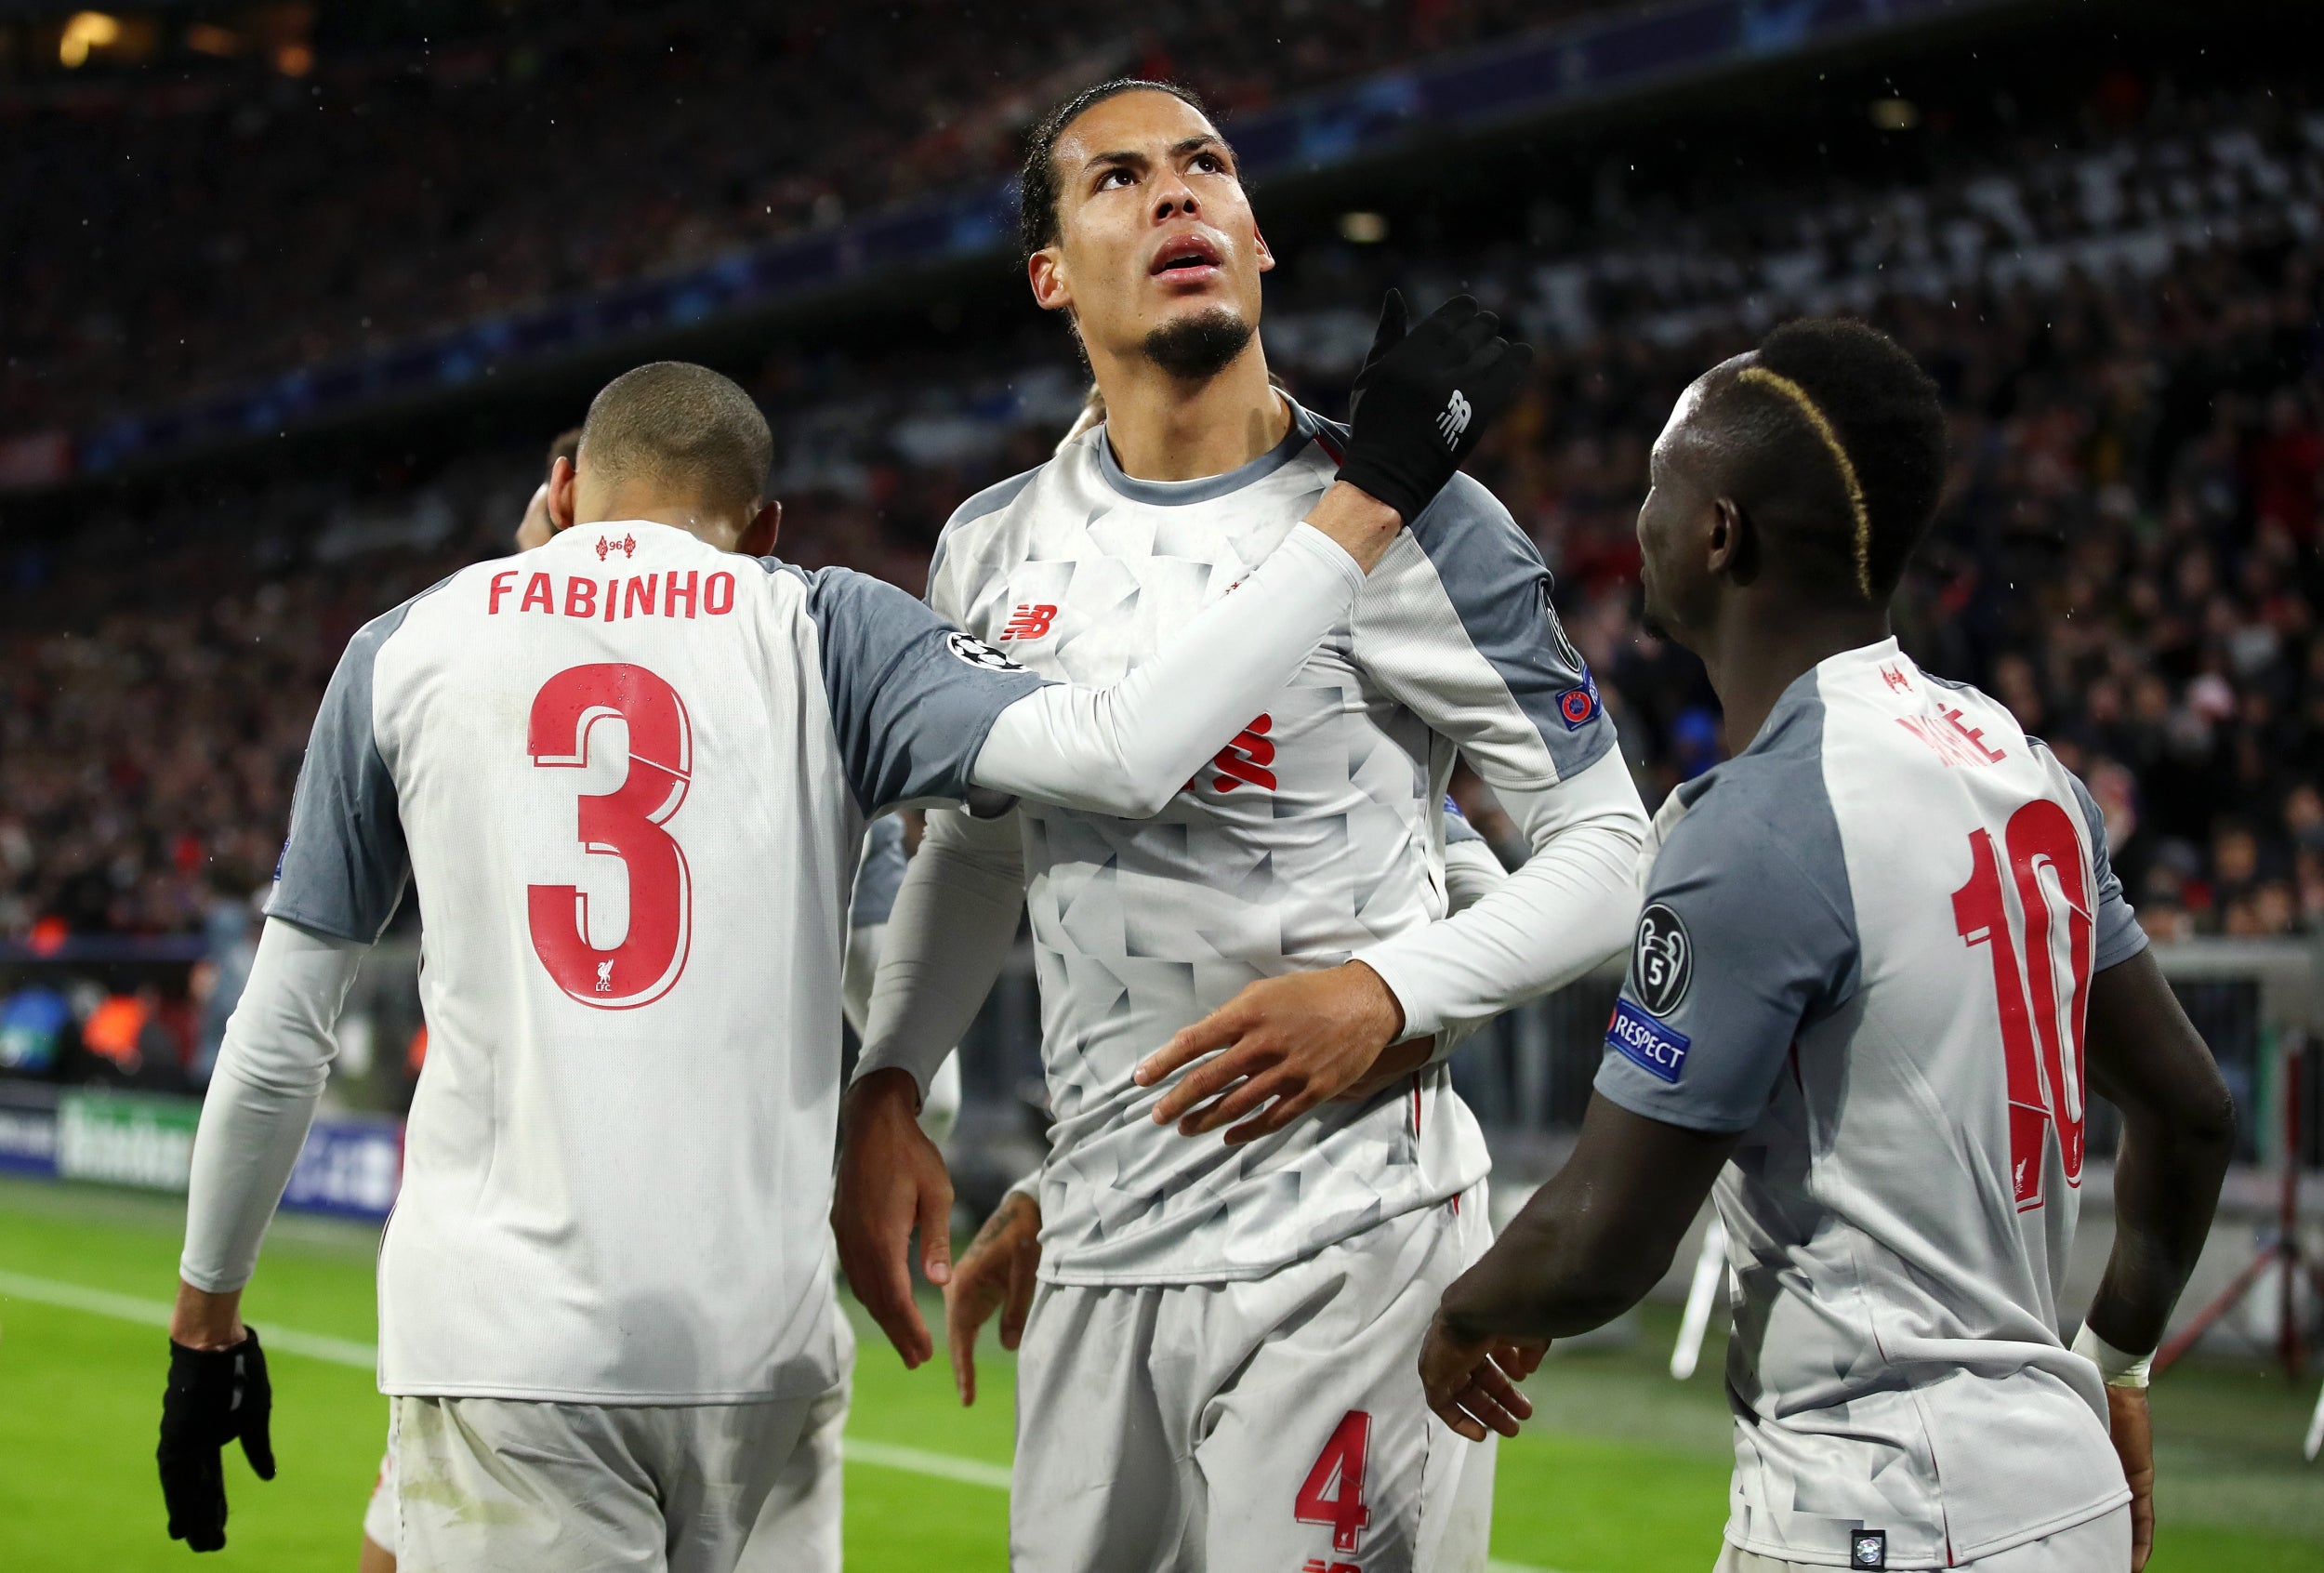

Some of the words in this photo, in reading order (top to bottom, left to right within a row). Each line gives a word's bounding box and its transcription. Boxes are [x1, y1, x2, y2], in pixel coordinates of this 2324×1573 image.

[609, 540, 623, 551] 96
[488, 570, 736, 623] FABINHO
[526, 662, 693, 1011] 3
[1647, 956, 1664, 986] 5
[1950, 799, 2094, 1214] 10
[1614, 1013, 1685, 1069] RESPECT
[1294, 1408, 1373, 1555] 4
